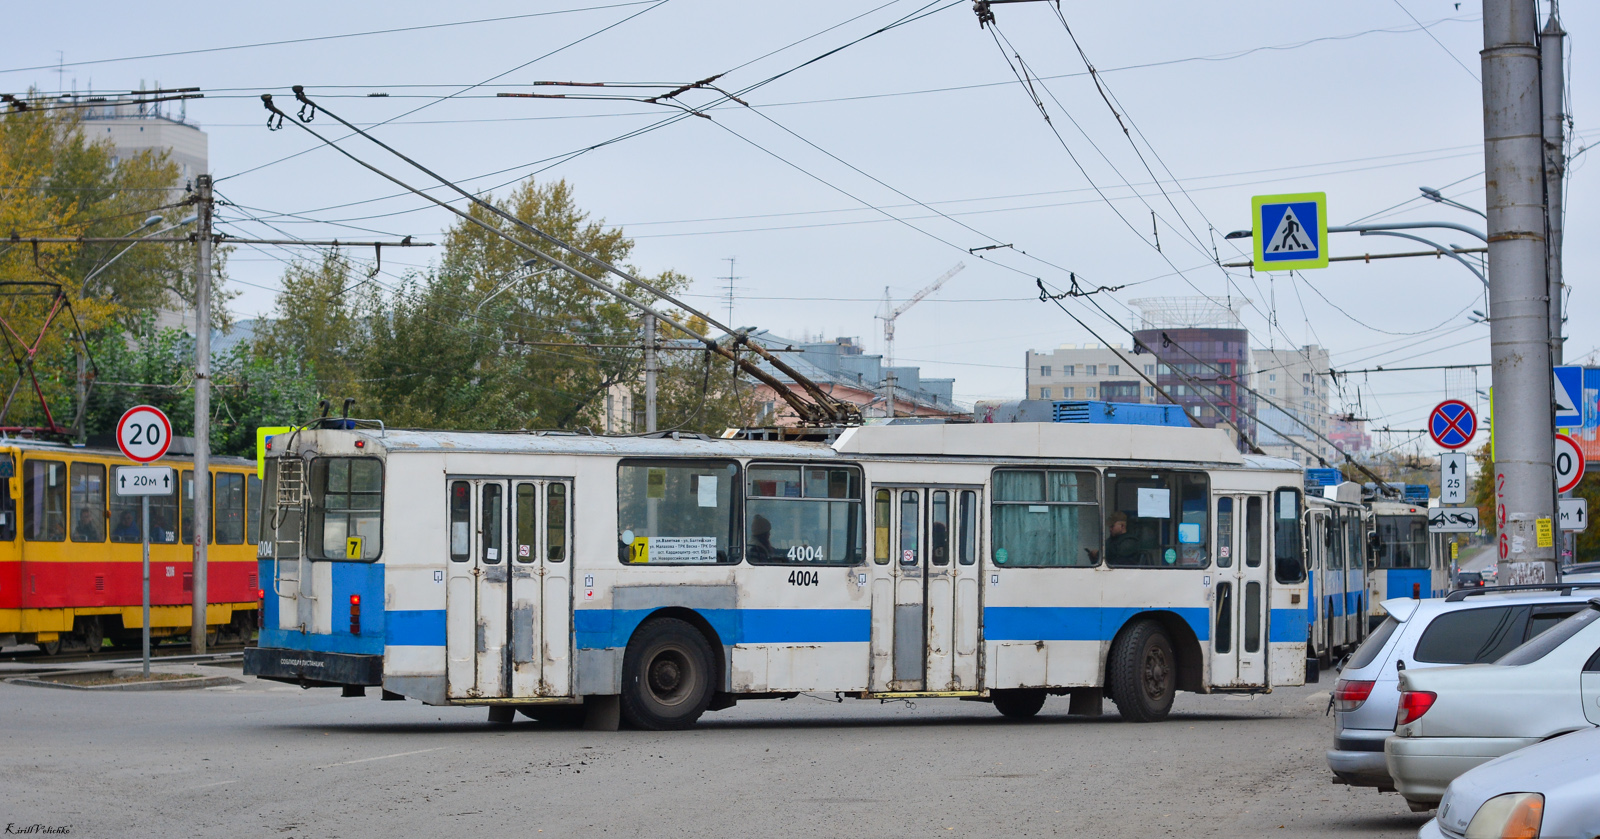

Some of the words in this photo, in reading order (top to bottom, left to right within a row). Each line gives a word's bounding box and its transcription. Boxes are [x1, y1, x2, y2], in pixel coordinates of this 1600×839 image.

[129, 423, 160, 445] 20
[1557, 452, 1571, 475] 0
[1447, 479, 1460, 489] 25
[350, 541, 358, 555] 7
[638, 543, 645, 557] 7
[787, 545, 823, 561] 4004
[788, 570, 819, 586] 4004
